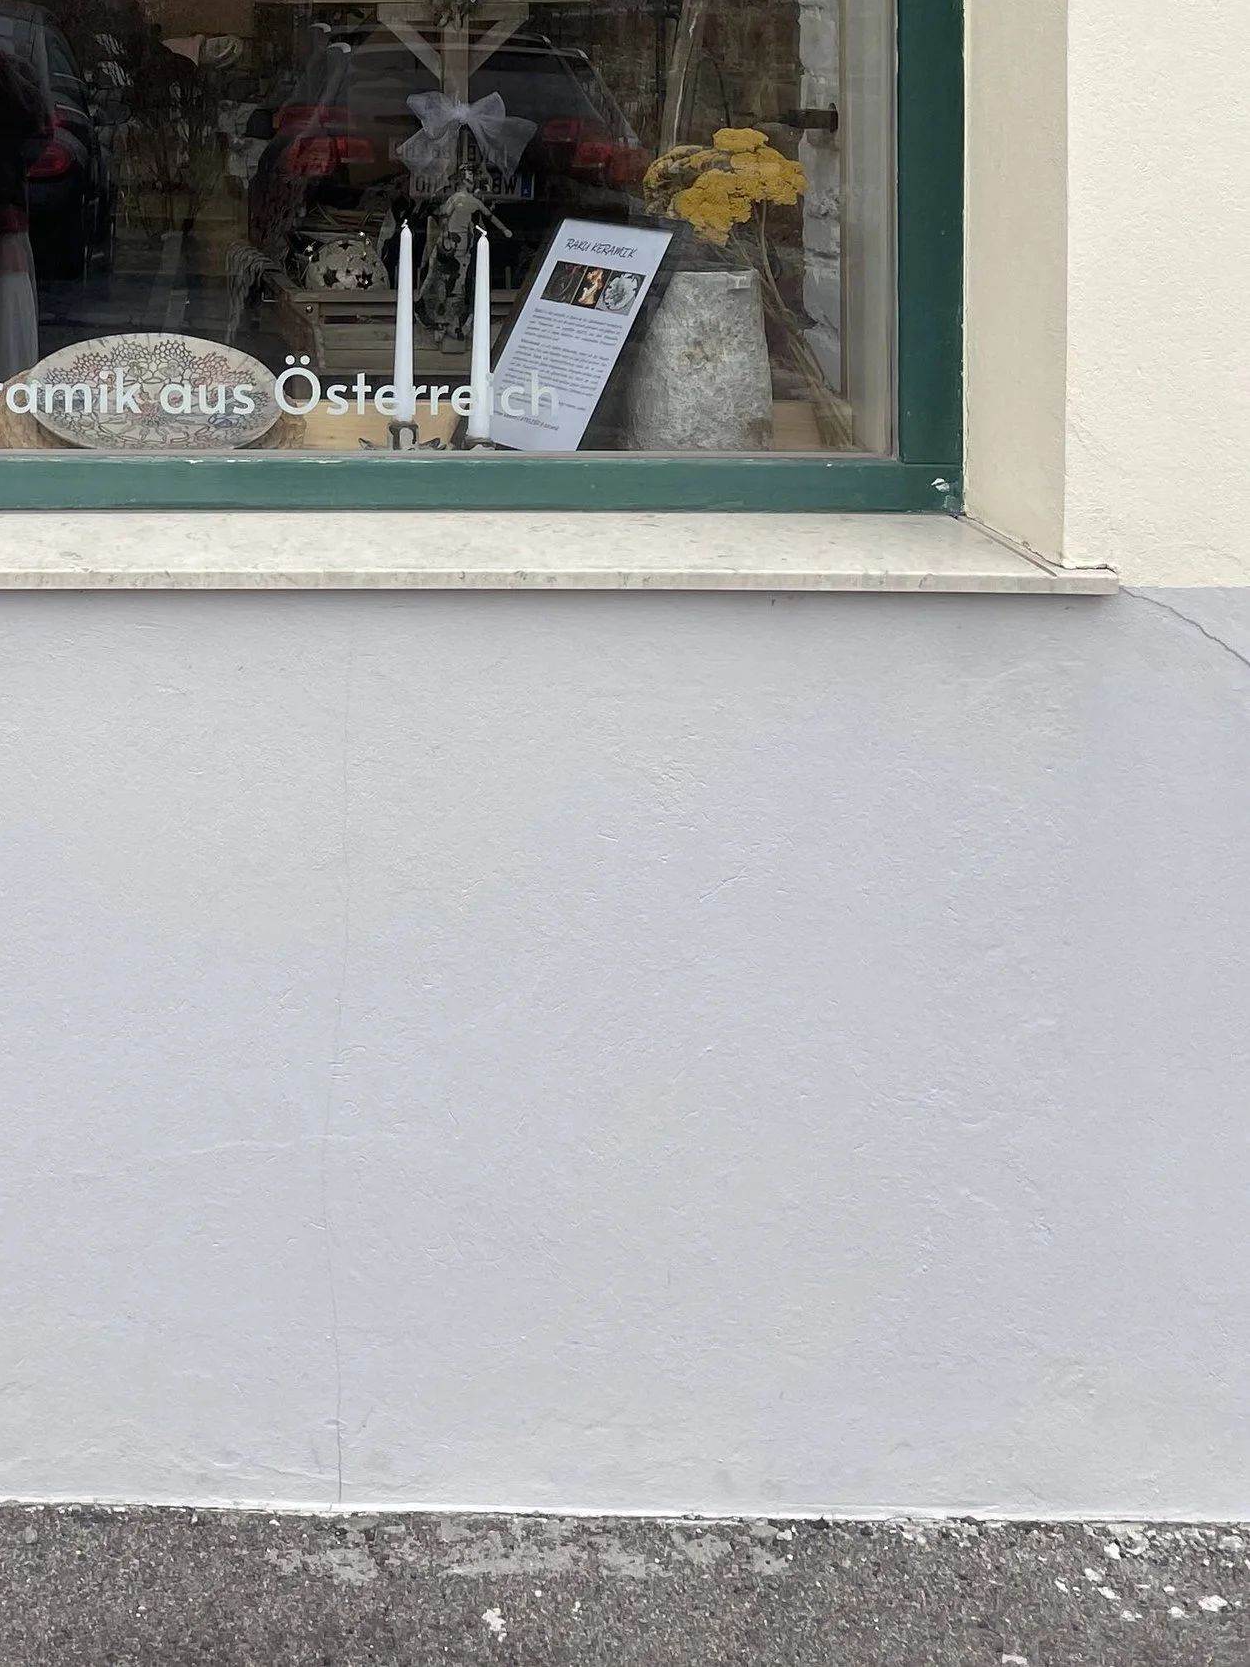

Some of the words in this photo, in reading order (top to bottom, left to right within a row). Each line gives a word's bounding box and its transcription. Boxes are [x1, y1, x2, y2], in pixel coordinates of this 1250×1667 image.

[565, 238, 592, 252] RAKU
[591, 242, 638, 259] KERAMIK
[159, 380, 256, 416] aus
[274, 354, 559, 417] Österreich
